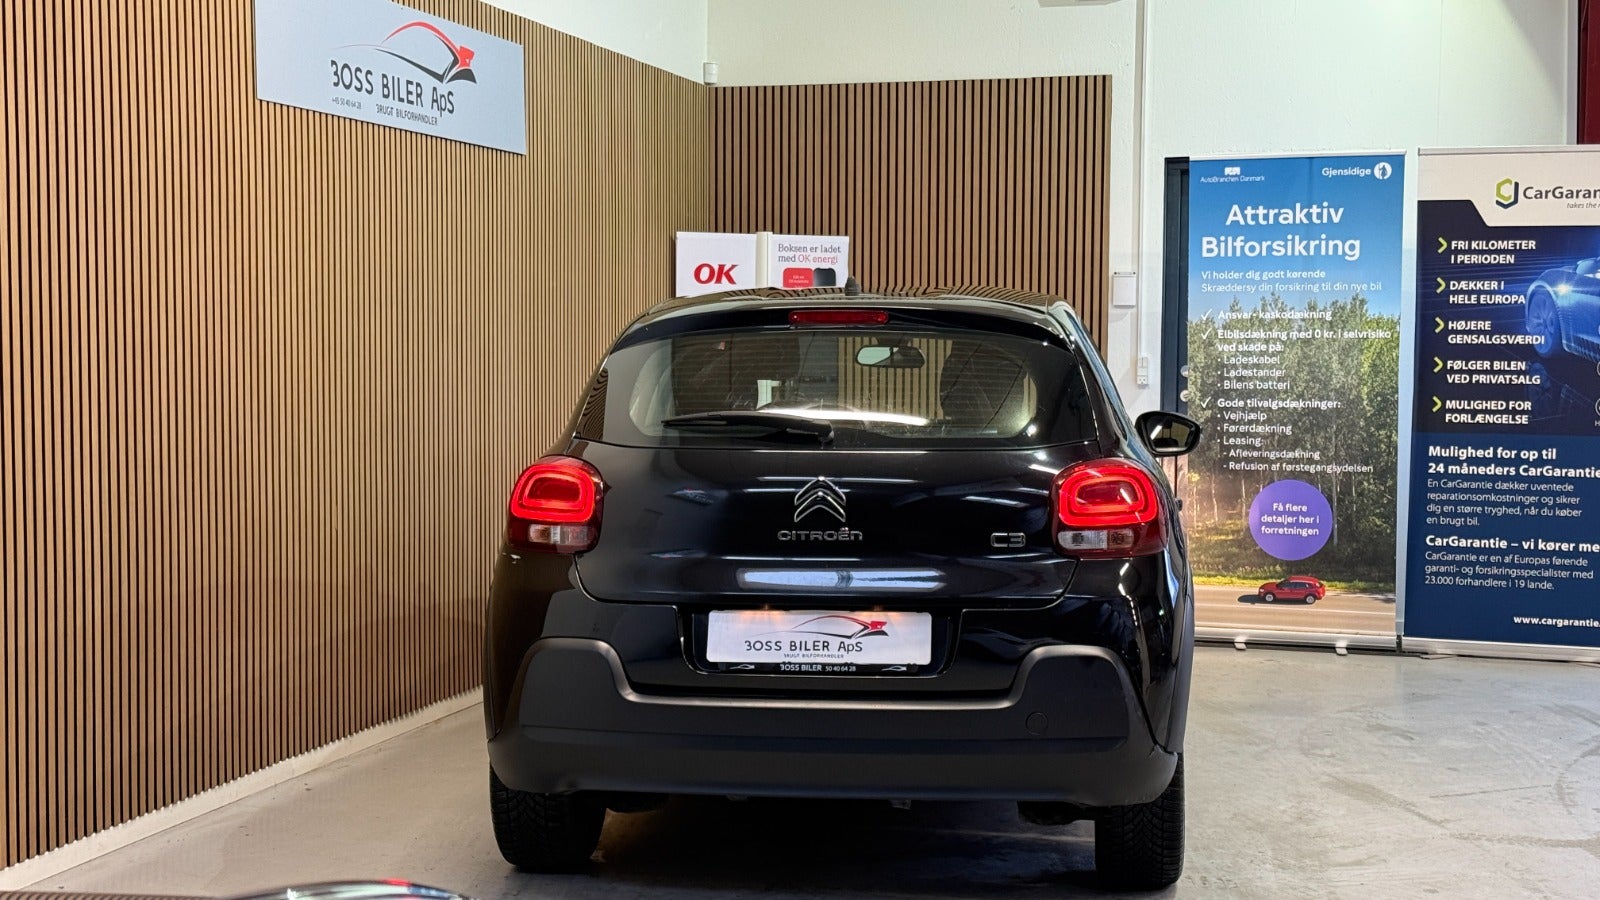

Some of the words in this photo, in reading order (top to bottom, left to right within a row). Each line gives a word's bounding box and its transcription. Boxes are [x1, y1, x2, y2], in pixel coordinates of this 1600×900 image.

[382, 74, 423, 107] BILER
[431, 87, 455, 117] ApS
[396, 108, 438, 125] BILFORHANDLER
[1322, 167, 1371, 178] Gjensidige
[1523, 186, 1600, 199] CarGaran
[1226, 201, 1344, 225] Attraktiv
[778, 243, 807, 253] Boksen
[820, 244, 841, 253] ladet
[1202, 234, 1360, 261] Bilforsikring
[1451, 240, 1468, 250] FRI
[1472, 240, 1536, 250] KILOMETER
[778, 254, 796, 262] med
[798, 254, 810, 262] OK
[813, 255, 838, 265] energi
[1451, 255, 1454, 263] I
[1457, 255, 1514, 263] PERIODEN
[694, 263, 739, 285] OK
[1202, 270, 1211, 280] Vi
[1213, 270, 1243, 279] holder
[1246, 270, 1260, 280] dig
[1262, 270, 1285, 280] godt
[1287, 270, 1326, 278] kørende
[1202, 283, 1256, 294] Skræddersy
[1259, 283, 1272, 291] din
[1275, 282, 1319, 293] forsikring
[1322, 282, 1331, 290] til
[1333, 282, 1348, 290] din
[1351, 284, 1367, 293] nye
[1370, 282, 1382, 290] bil
[1450, 281, 1498, 290] DÆKKER
[1501, 281, 1504, 290] I
[1450, 295, 1477, 304] HELE
[1480, 295, 1525, 304] EUROPA
[1259, 310, 1332, 321] kaskodækning
[1448, 321, 1491, 330] HØJERE
[1218, 330, 1287, 340] Elbilsdækning
[1290, 330, 1312, 339] med
[1315, 330, 1321, 338] 0
[1324, 330, 1336, 338] kr.
[1338, 330, 1341, 338] i
[1343, 330, 1391, 339] selvrisiko
[1448, 335, 1545, 344] GENSALGSVÆRDI
[1218, 343, 1235, 351] ved
[1238, 343, 1266, 351] skade
[1269, 343, 1284, 352] på:
[1224, 356, 1280, 364] Ladeskabel
[1447, 360, 1490, 370] FØLGER
[1493, 361, 1525, 370] BILEN
[1224, 368, 1286, 377] Ladestander
[1447, 374, 1469, 384] VED
[1472, 375, 1541, 385] PRIVATSALG
[1224, 381, 1253, 389] Bilens
[1257, 381, 1290, 390] batteri
[1218, 399, 1244, 408] Gode
[1246, 398, 1340, 409] tilvalgsdækninger:
[1445, 400, 1506, 410] MULIGHED
[1509, 401, 1531, 410] FOR
[1224, 412, 1267, 421] Vejhjælp
[1445, 414, 1528, 424] FORLÆNGELSE
[1224, 424, 1292, 435] Førerdækning
[1224, 437, 1264, 447] Leasing:
[1229, 449, 1320, 460] Afleveringsdækning
[1428, 446, 1493, 460] Mulighed
[1497, 447, 1517, 458] for
[1520, 450, 1538, 461] op
[1542, 448, 1556, 459] til
[1229, 462, 1268, 471] Refusion
[1271, 462, 1280, 471] af
[1282, 463, 1373, 474] førstegangsydelsen
[1428, 463, 1444, 473] 24
[1448, 463, 1515, 475] måneders
[1519, 465, 1600, 478] CarGarantie
[1428, 479, 1438, 488] En
[1440, 480, 1492, 489] CarGarantie
[1495, 481, 1528, 490] dækker
[1530, 483, 1574, 492] uventede
[1427, 492, 1538, 504] reparationsomkostninger
[1541, 496, 1553, 505] og
[1555, 495, 1580, 504] sikrer
[1273, 503, 1283, 512] Få
[1285, 504, 1307, 512] flere
[1427, 504, 1440, 514] dig
[1485, 506, 1522, 516] tryghed,
[1524, 507, 1539, 515] når
[1541, 507, 1553, 516] du
[1555, 507, 1582, 516] køber
[1261, 514, 1296, 525] detaljer
[1440, 516, 1464, 527] brugt
[1466, 516, 1480, 526] bil.
[1261, 526, 1319, 536] forretningen
[778, 527, 863, 541] CITROËN
[990, 532, 1026, 548] C3
[1426, 535, 1507, 548] CarGarantie
[1522, 539, 1534, 549] vi
[1538, 539, 1575, 551] kører
[1425, 552, 1477, 561] CarGarantie
[1504, 554, 1513, 562] af
[1514, 555, 1550, 565] Europas
[1552, 556, 1588, 566] førende
[1425, 564, 1459, 574] garanti-
[1461, 567, 1473, 575] og
[1476, 566, 1570, 578] forsikringsspecialister
[1572, 570, 1593, 579] med
[1425, 576, 1453, 584] 23.000
[1456, 576, 1506, 587] forhandlere
[1515, 580, 1525, 588] 19
[1527, 580, 1554, 590] lande.
[789, 641, 830, 652] BILER
[838, 641, 863, 654] ApS
